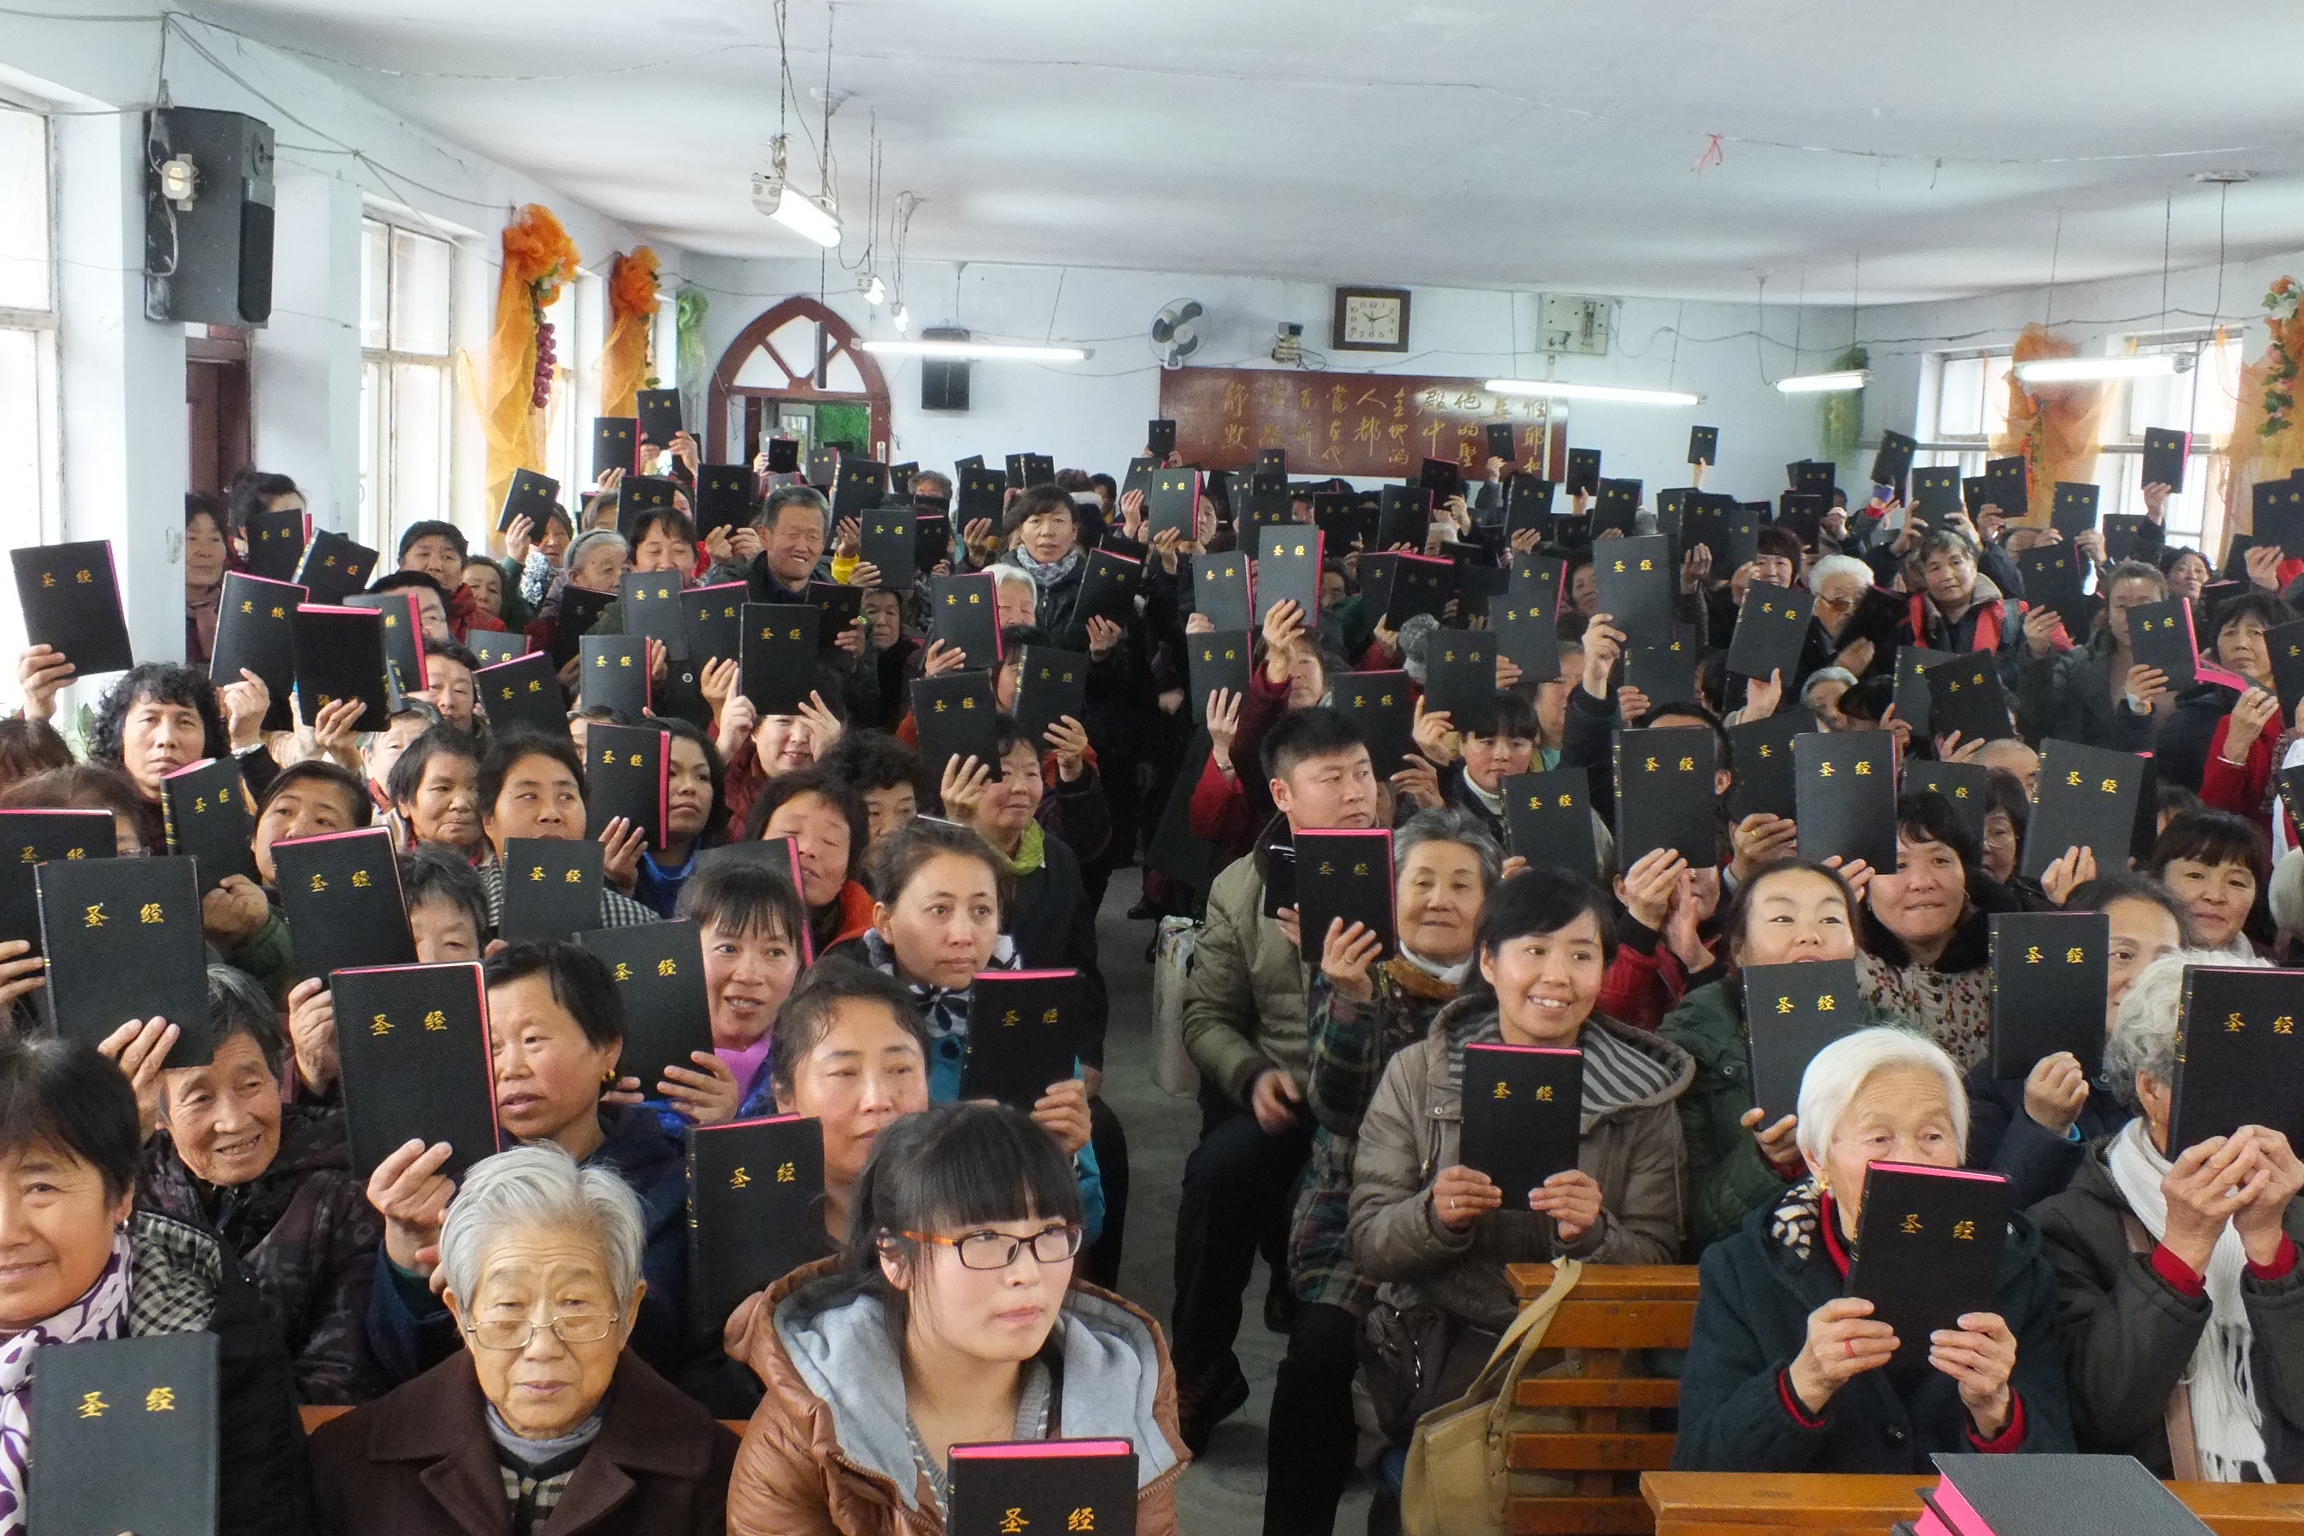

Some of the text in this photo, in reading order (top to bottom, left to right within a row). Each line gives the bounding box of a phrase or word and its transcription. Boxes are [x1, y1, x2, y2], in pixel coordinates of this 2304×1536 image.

[1273, 544, 1306, 557] 圣经
[324, 555, 359, 576] 圣经
[1614, 559, 1653, 573] 圣经
[42, 568, 93, 588] 圣经
[635, 588, 669, 601] 圣经
[946, 593, 981, 606] 圣经
[241, 600, 285, 619] 圣经
[700, 606, 735, 621] 圣经
[1507, 607, 1541, 621] 圣经
[1762, 602, 1798, 621] 圣经
[761, 627, 801, 640] 圣经
[2143, 616, 2175, 632] 圣经
[479, 649, 513, 663] 圣经
[596, 655, 632, 667] 圣经
[1203, 649, 1236, 662] 圣经
[1444, 650, 1481, 663] 圣经
[1040, 667, 1073, 683] 圣经
[1950, 673, 1985, 692] 圣经
[502, 679, 542, 700] 圣经
[934, 697, 975, 713] 圣经
[1353, 694, 1393, 708] 圣经
[602, 749, 643, 767] 圣经
[1645, 756, 1695, 772] 圣经
[1820, 760, 1872, 777] 圣经
[2067, 770, 2118, 794] 圣经
[195, 788, 230, 813] 圣经
[1529, 794, 1572, 810] 圣经
[21, 845, 86, 864] 圣经
[530, 866, 581, 883] 圣经
[1319, 861, 1369, 876] 圣经
[310, 869, 372, 892] 圣经
[84, 902, 164, 928] 圣经
[2026, 945, 2084, 964] 圣经
[614, 958, 677, 981] 圣经
[1776, 994, 1835, 1014] 圣经
[371, 1010, 447, 1036] 圣经
[1001, 1008, 1060, 1028] 圣经
[2226, 1012, 2294, 1035] 圣经
[1494, 1081, 1554, 1102] 圣经
[730, 1162, 796, 1189] 圣经
[1902, 1213, 1976, 1241] 圣经
[77, 1386, 176, 1419] 圣经
[999, 1506, 1095, 1534] 圣经
